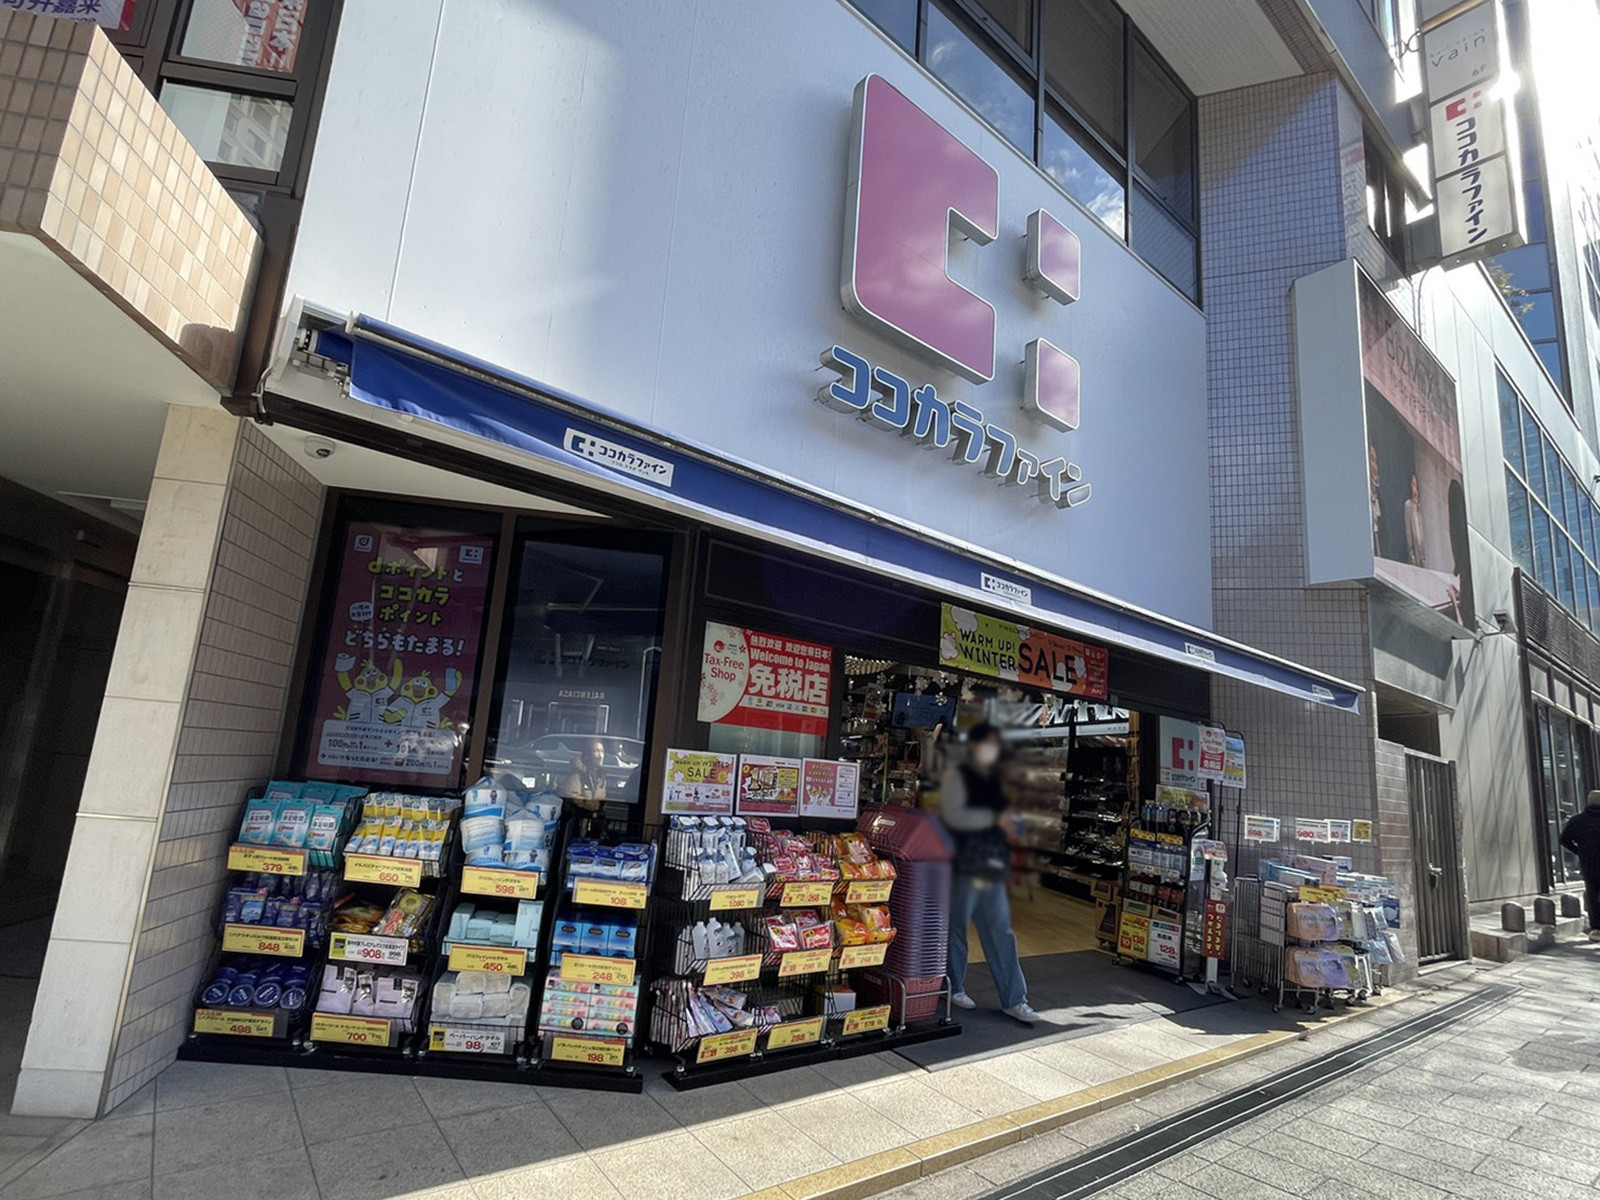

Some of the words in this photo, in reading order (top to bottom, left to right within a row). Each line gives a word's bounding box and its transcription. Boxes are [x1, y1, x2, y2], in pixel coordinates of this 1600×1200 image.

[1431, 35, 1486, 67] vain
[1455, 116, 1488, 244] ココカラファイン
[826, 344, 1092, 508] ココカラファイン
[598, 445, 668, 475] ココカラファイン
[378, 583, 451, 607] ココカラ
[377, 603, 442, 627] ポイント
[959, 628, 994, 649] WARM
[997, 639, 1016, 655] UP!
[704, 652, 745, 670] Tax-Free
[750, 647, 793, 667] Welcome
[794, 659, 805, 669] to
[805, 658, 830, 674] Japan
[958, 643, 1018, 673] WINTER
[1018, 642, 1078, 686] SALE
[710, 667, 737, 683] Shop
[748, 662, 829, 705] 免税店
[687, 766, 717, 780] SALE
[1296, 829, 1315, 838] 980
[262, 862, 283, 873] 379
[379, 872, 399, 882] 650
[495, 884, 515, 894] 598
[611, 897, 627, 905] 108
[258, 941, 280, 952] 848
[362, 949, 382, 959] 908
[483, 962, 503, 971] 450
[592, 971, 613, 980] 248
[230, 1025, 251, 1034] 498
[346, 1032, 367, 1042] 700
[465, 1040, 482, 1050] 98
[587, 1053, 605, 1062] 198
